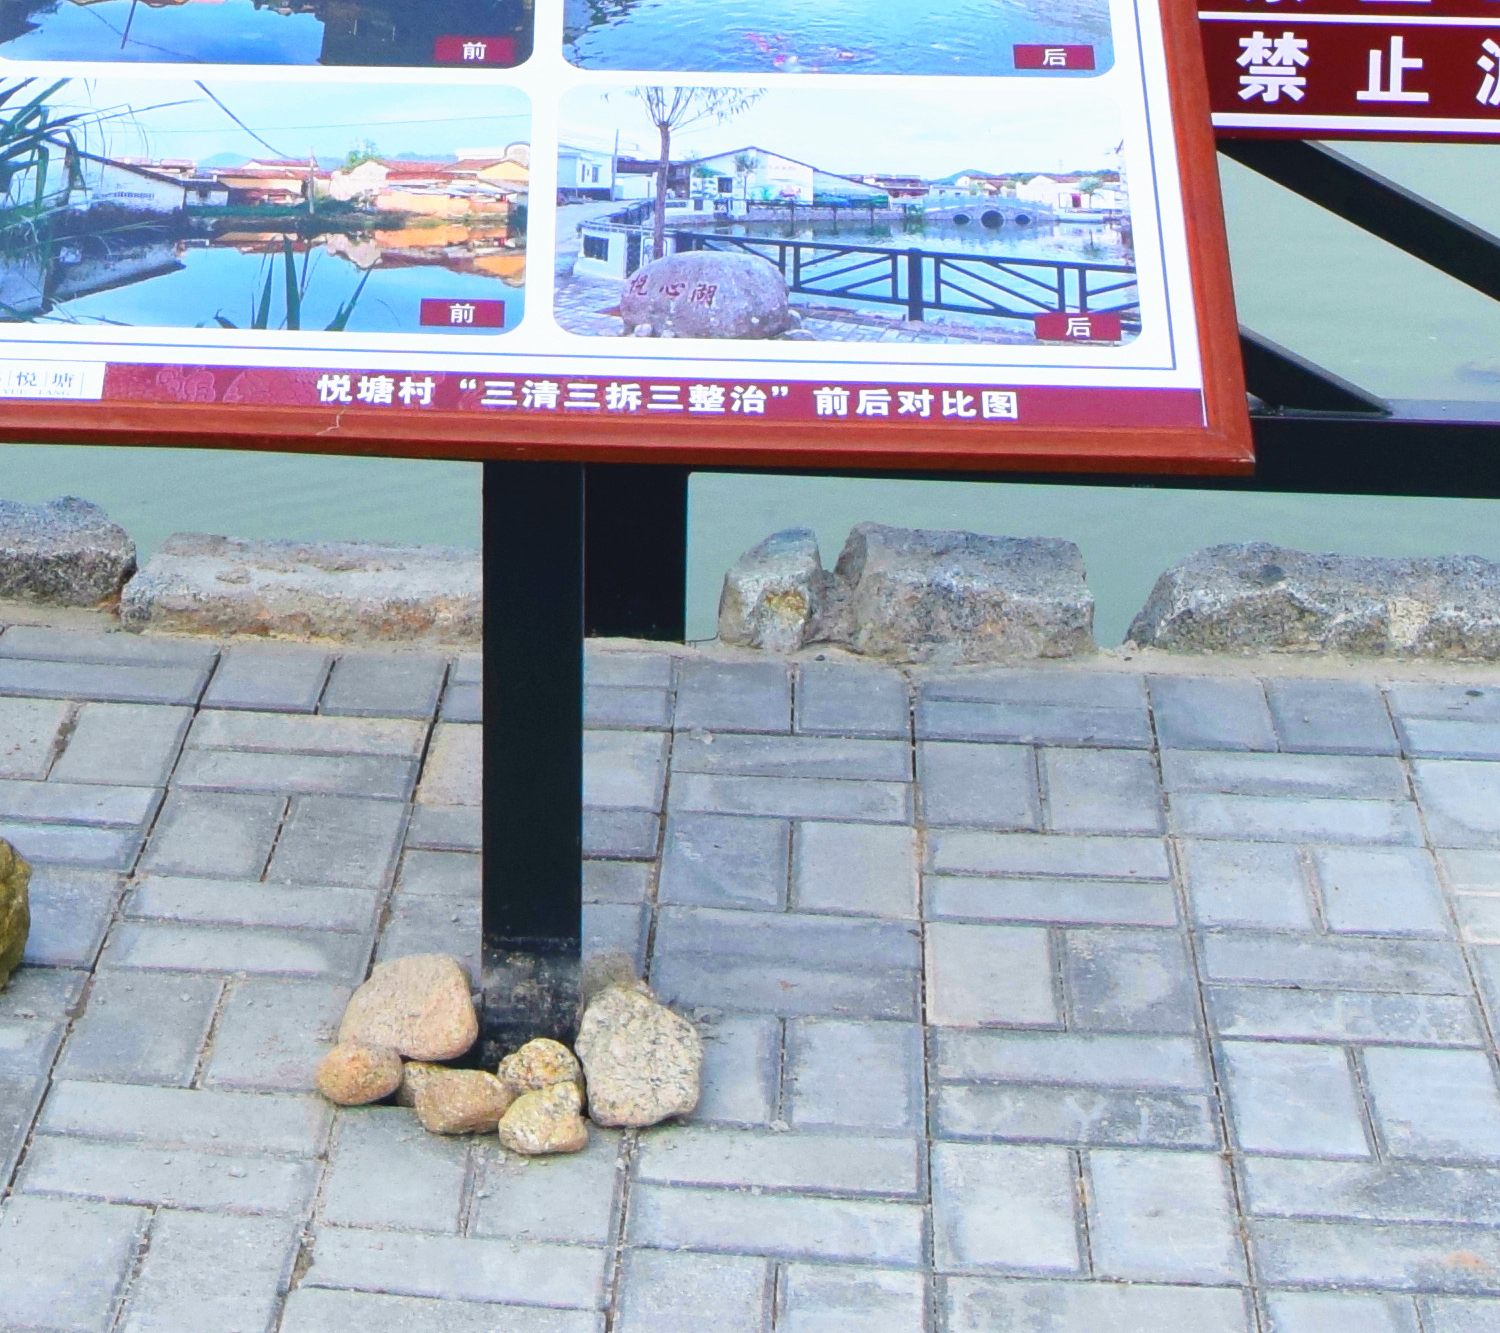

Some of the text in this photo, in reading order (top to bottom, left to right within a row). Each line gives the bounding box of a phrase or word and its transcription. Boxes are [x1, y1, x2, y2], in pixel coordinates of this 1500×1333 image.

[462, 41, 487, 60] 前
[1042, 47, 1068, 66] 后
[449, 302, 476, 324] 前
[1065, 317, 1092, 338] 后
